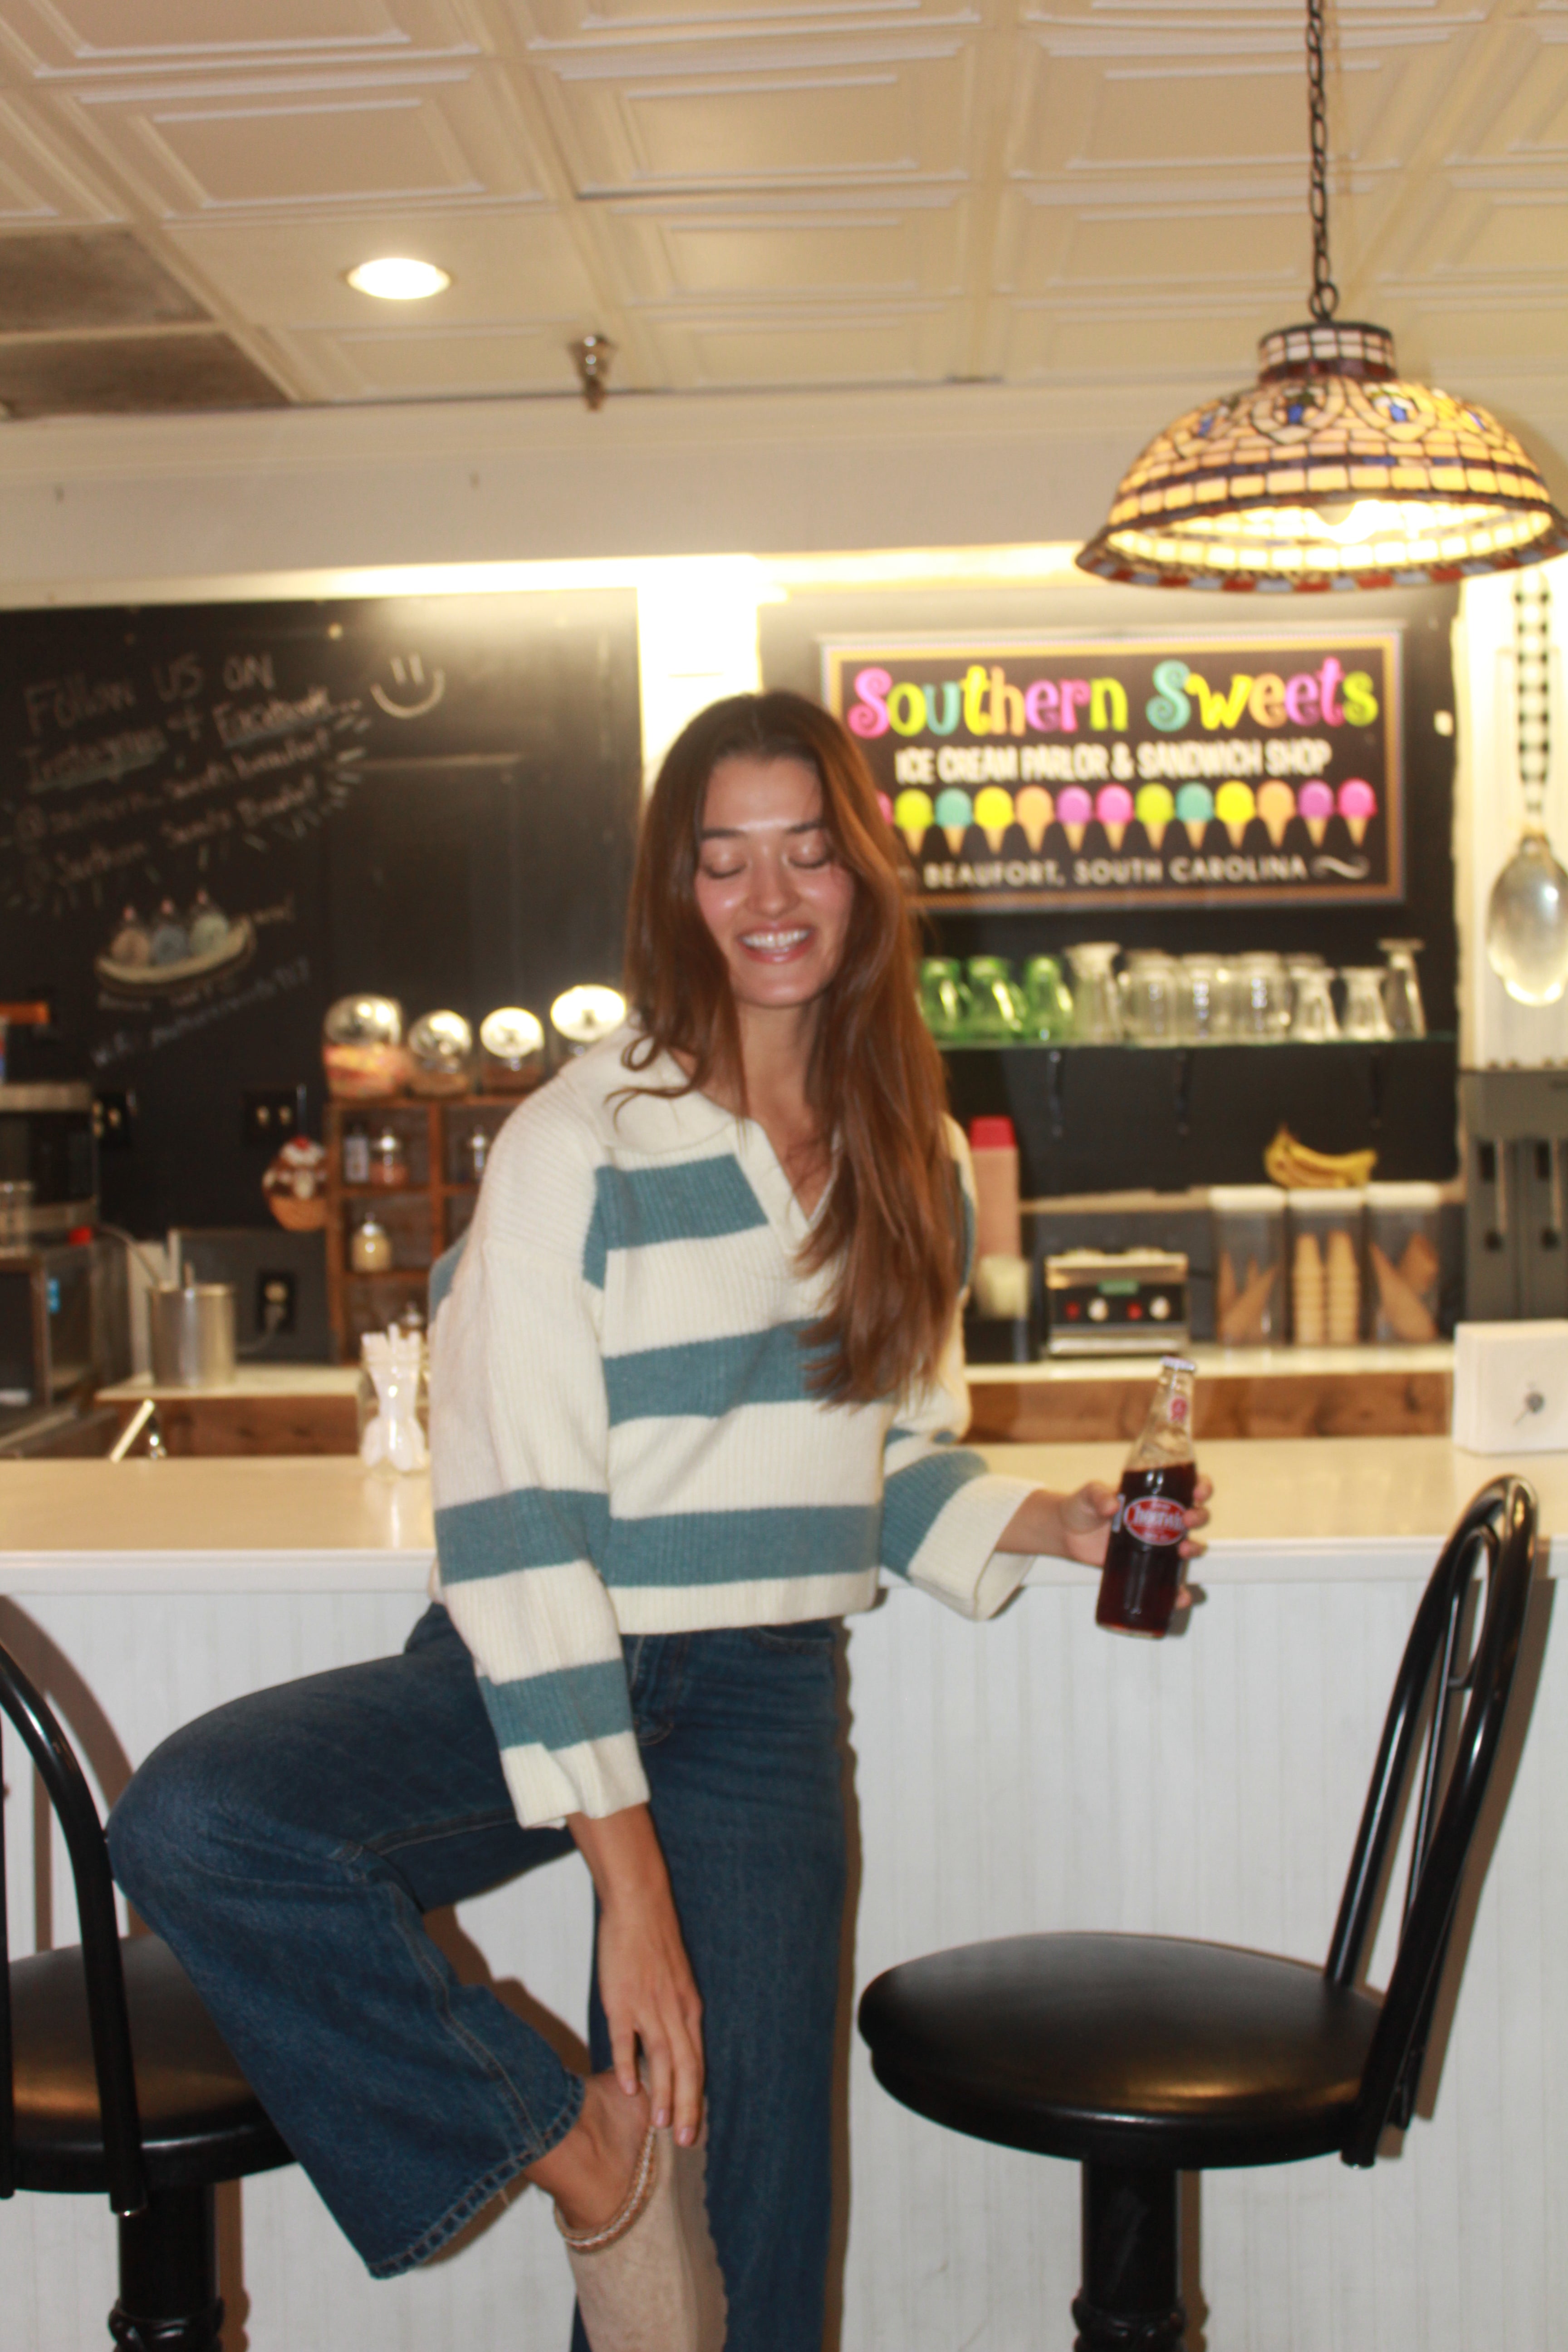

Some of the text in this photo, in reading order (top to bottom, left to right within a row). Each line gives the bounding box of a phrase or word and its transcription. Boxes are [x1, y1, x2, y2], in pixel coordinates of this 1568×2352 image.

[848, 657, 1378, 739] Southern Sweets
[895, 736, 1333, 784] ICE CREAM PARLOR & SANDWICH SHOP
[924, 854, 1308, 889] BEAUFORT, SOUTH CAROLINA
